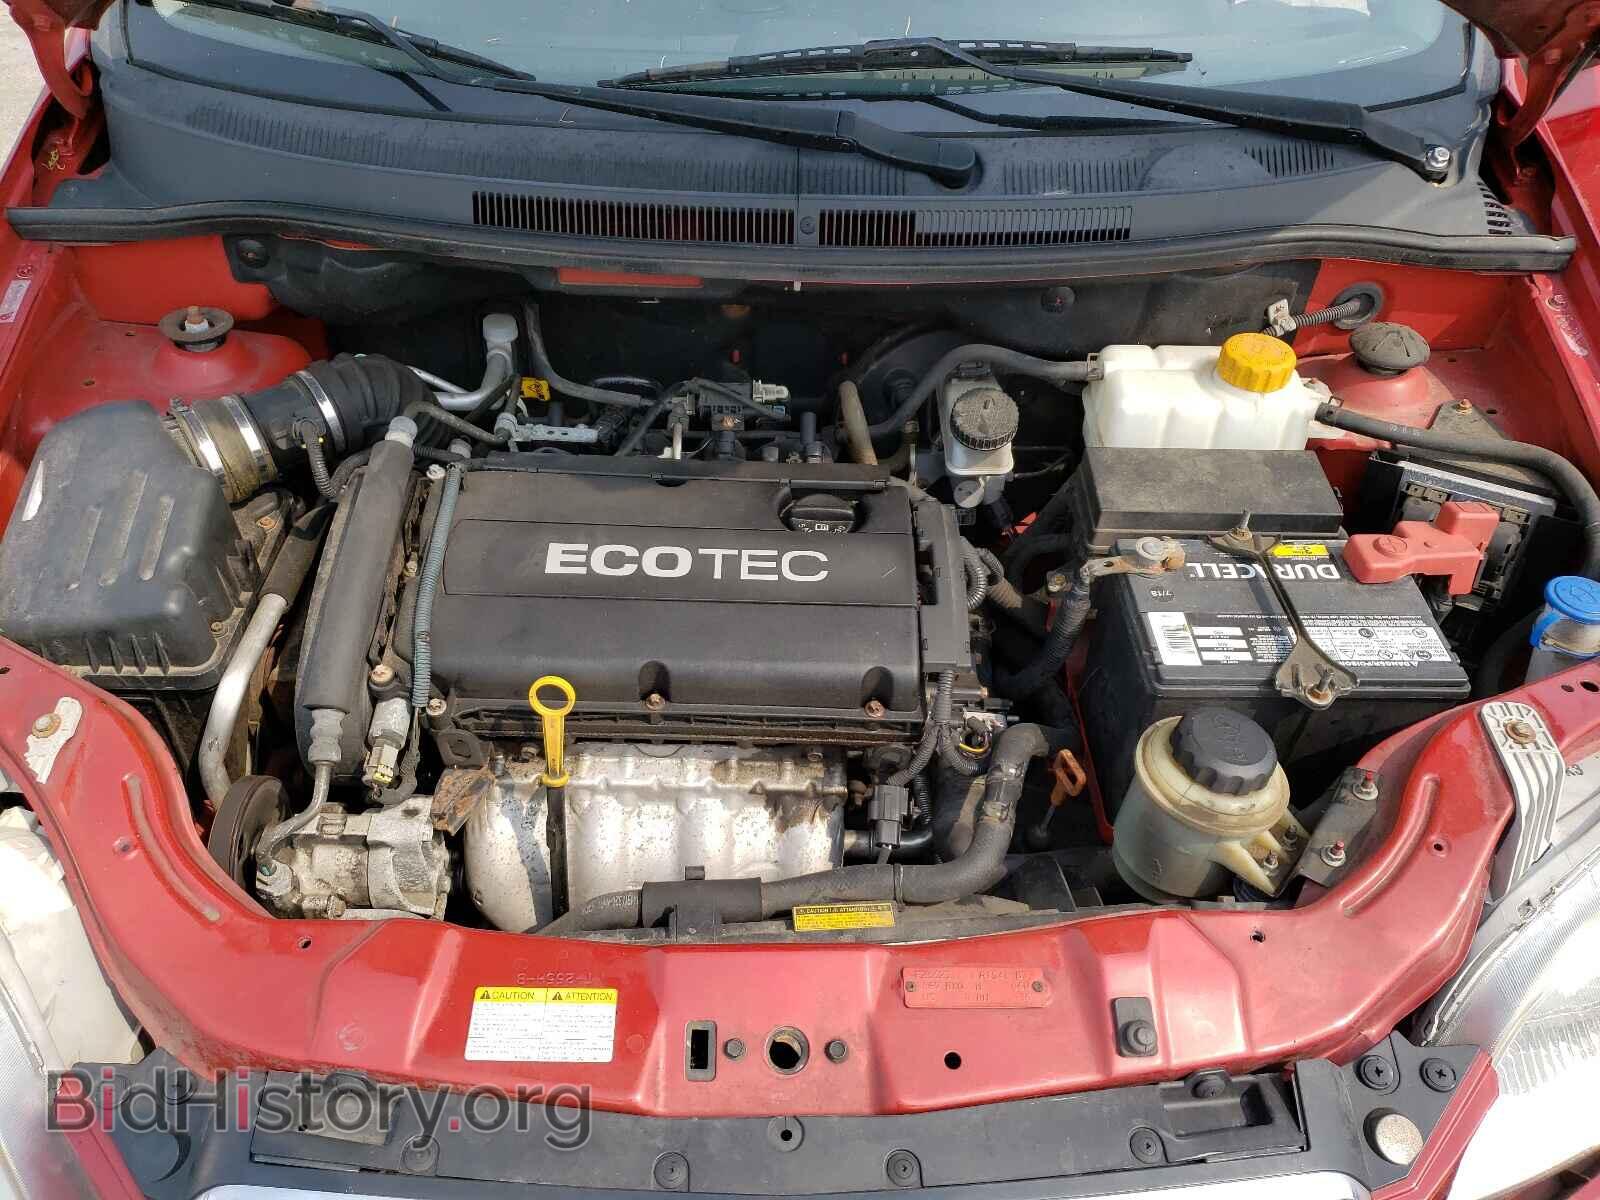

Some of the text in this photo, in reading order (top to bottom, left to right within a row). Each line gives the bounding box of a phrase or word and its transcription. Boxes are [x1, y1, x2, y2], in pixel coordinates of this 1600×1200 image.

[544, 542, 829, 582] ECOTEC
[492, 991, 613, 1001] CAUTION ATTENTION
